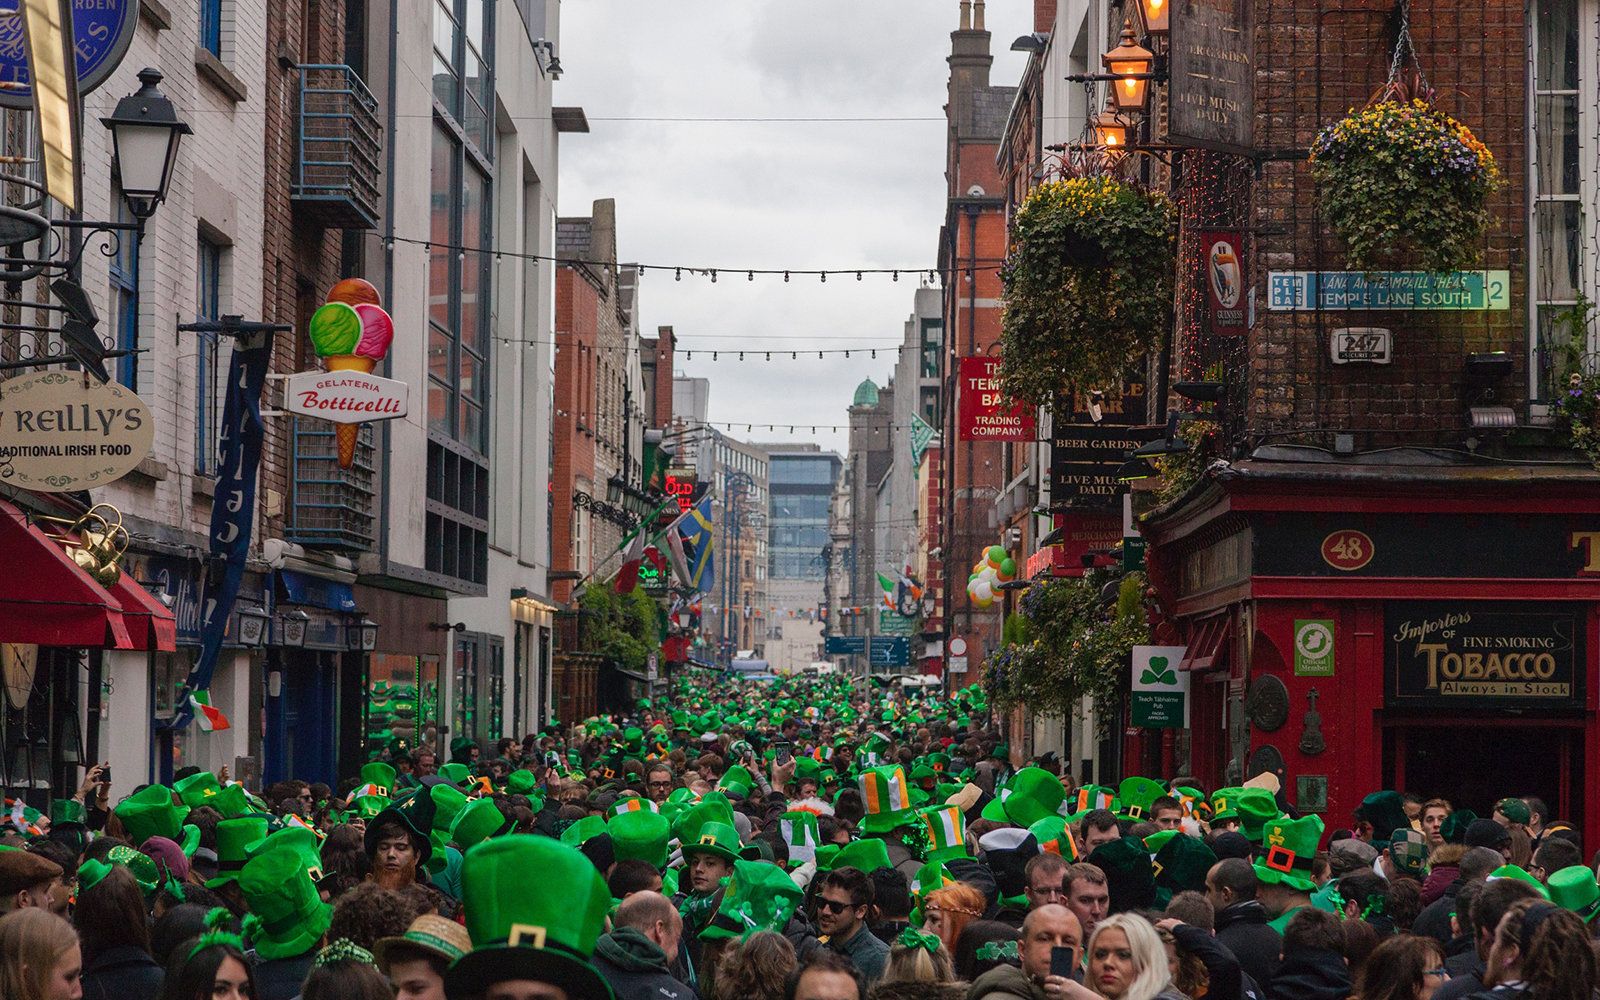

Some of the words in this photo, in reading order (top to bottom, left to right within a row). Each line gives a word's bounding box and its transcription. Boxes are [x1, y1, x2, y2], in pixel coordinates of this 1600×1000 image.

[75, 0, 116, 10] RDEN
[1490, 281, 1503, 300] 2
[1274, 297, 1302, 305] BAR
[1318, 292, 1372, 305] TEMPLE
[1377, 292, 1415, 305] LANE
[1421, 292, 1472, 305] SOUTH
[984, 363, 1003, 375] TH
[316, 379, 380, 393] GELATERIA
[969, 378, 1004, 391] TEM
[297, 391, 400, 414] Botticelli
[975, 416, 1021, 425] TRADING
[971, 426, 1024, 436] COMPANY
[65, 445, 97, 457] IRISH
[100, 444, 132, 456] FOOD
[1056, 439, 1088, 449] BEER
[1090, 439, 1143, 450] GARDEN
[1060, 475, 1091, 485] LIVE
[665, 481, 693, 495] OLD
[1079, 485, 1118, 495] DAILY
[1330, 535, 1363, 560] 48
[1394, 611, 1472, 643] Importers
[1442, 629, 1456, 639] OF
[1463, 636, 1493, 648] FINE
[1494, 636, 1555, 648] SMOKING
[1414, 643, 1556, 690] TOBACCO
[1443, 682, 1497, 694] Always
[1504, 684, 1518, 693] in
[1523, 682, 1568, 694] Stock
